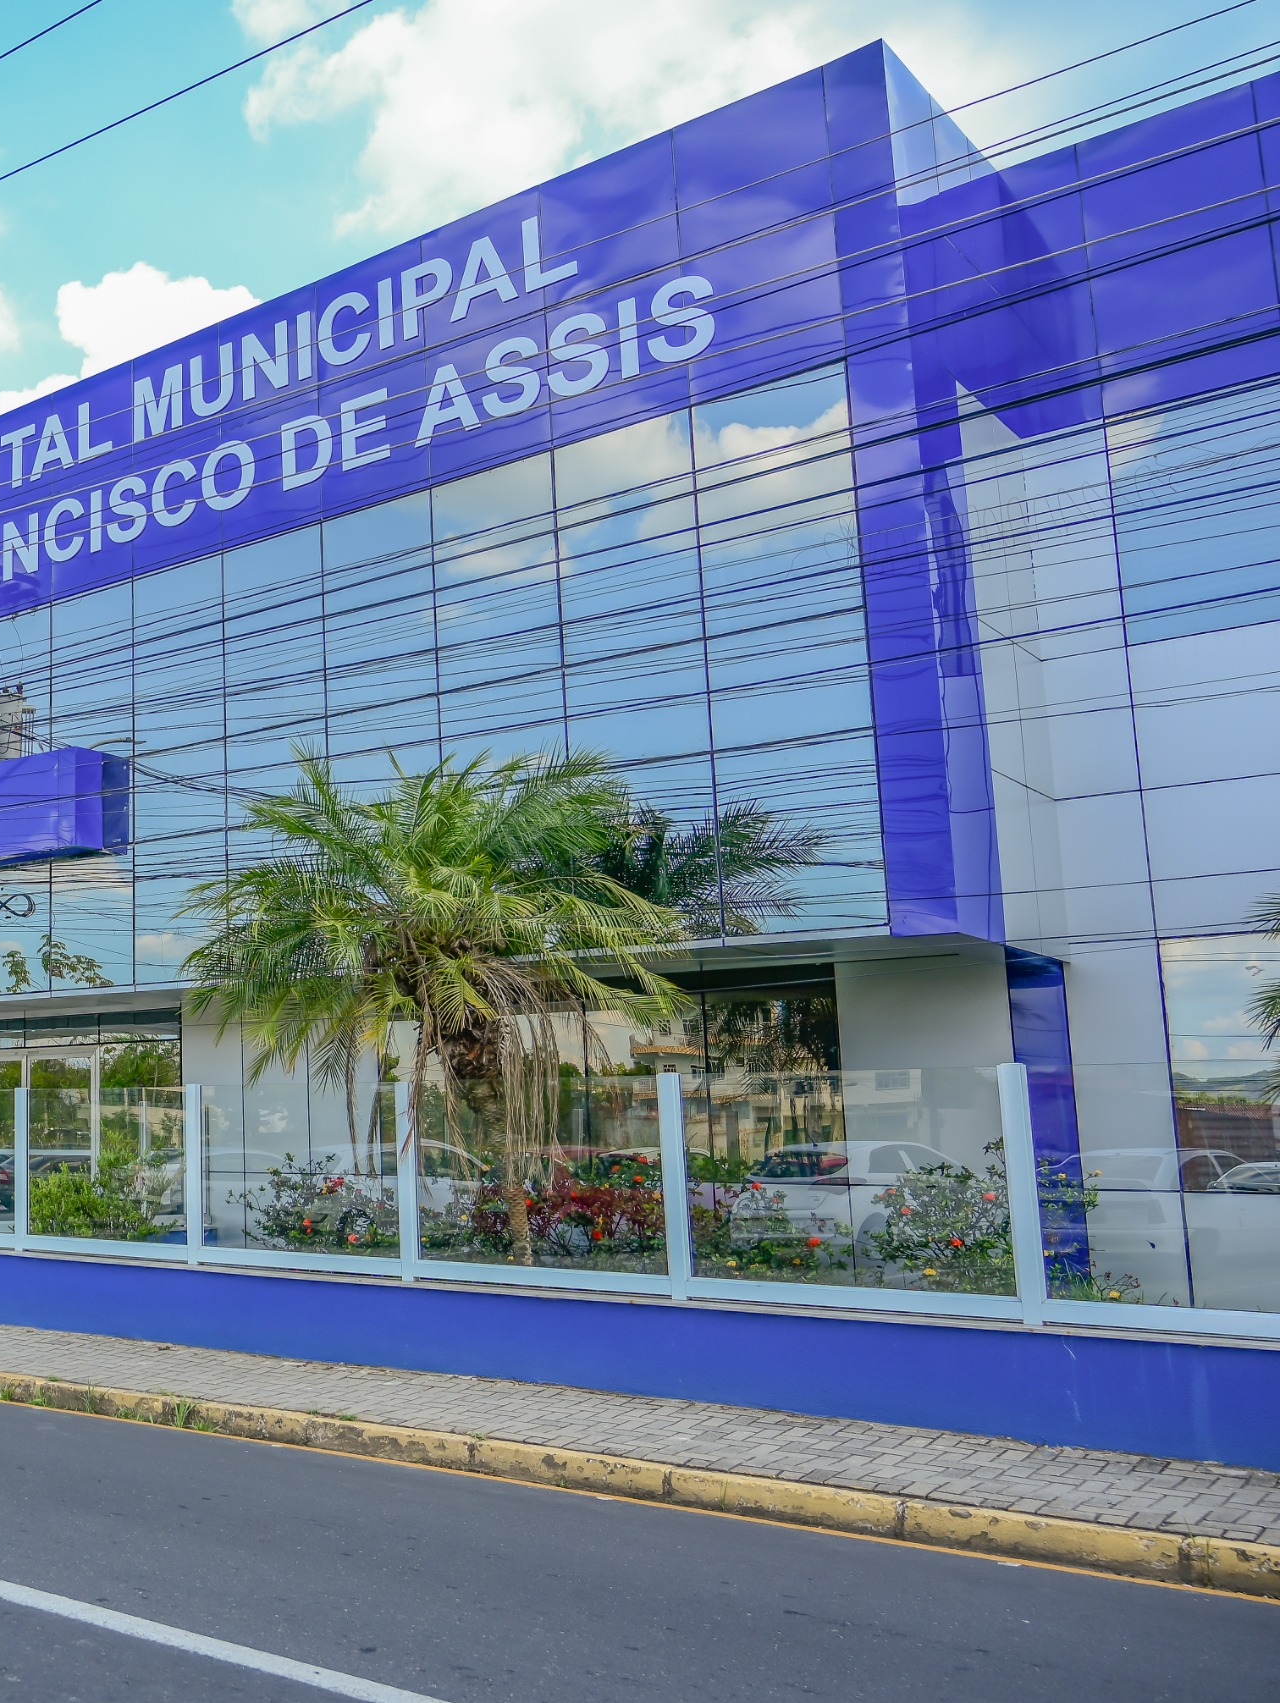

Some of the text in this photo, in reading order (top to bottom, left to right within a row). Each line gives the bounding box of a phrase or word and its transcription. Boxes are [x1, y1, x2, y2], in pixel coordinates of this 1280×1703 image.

[132, 214, 579, 440] MUNICIPAL
[281, 387, 392, 492] DE
[415, 274, 717, 450] ASSIS
